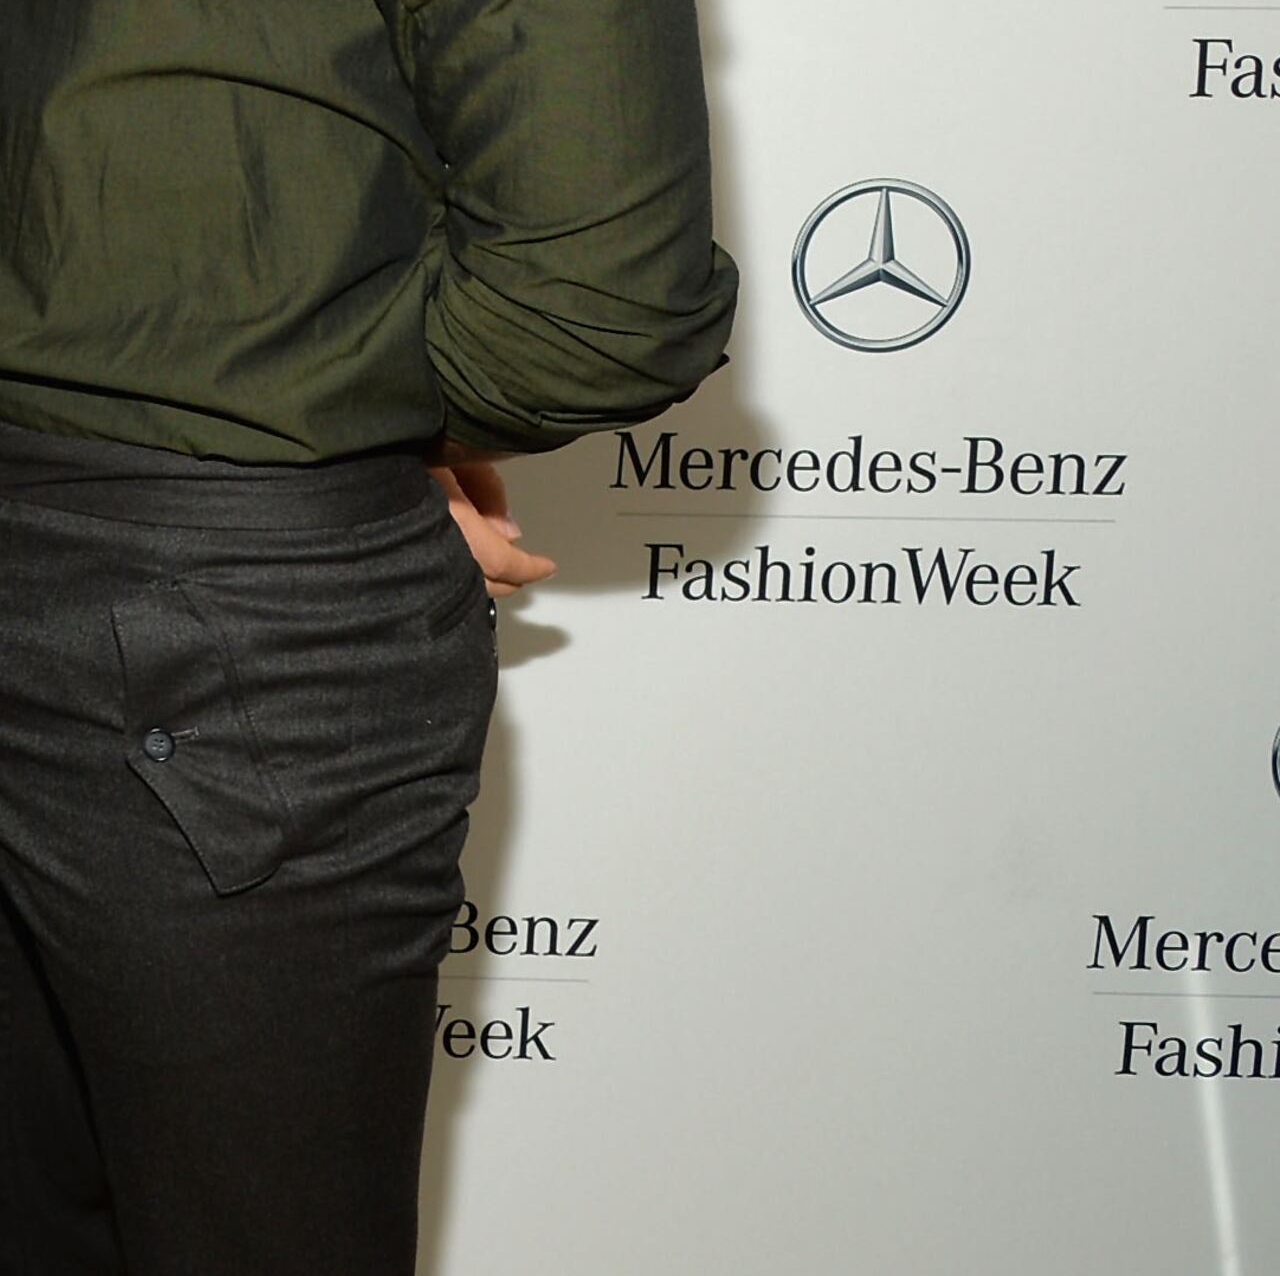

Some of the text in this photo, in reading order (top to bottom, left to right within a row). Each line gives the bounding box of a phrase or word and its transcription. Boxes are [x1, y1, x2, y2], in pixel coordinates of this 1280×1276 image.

[608, 431, 1128, 497] Mercedes-Benz
[640, 544, 1082, 608] FashionWeek
[436, 1004, 557, 1061] eek
